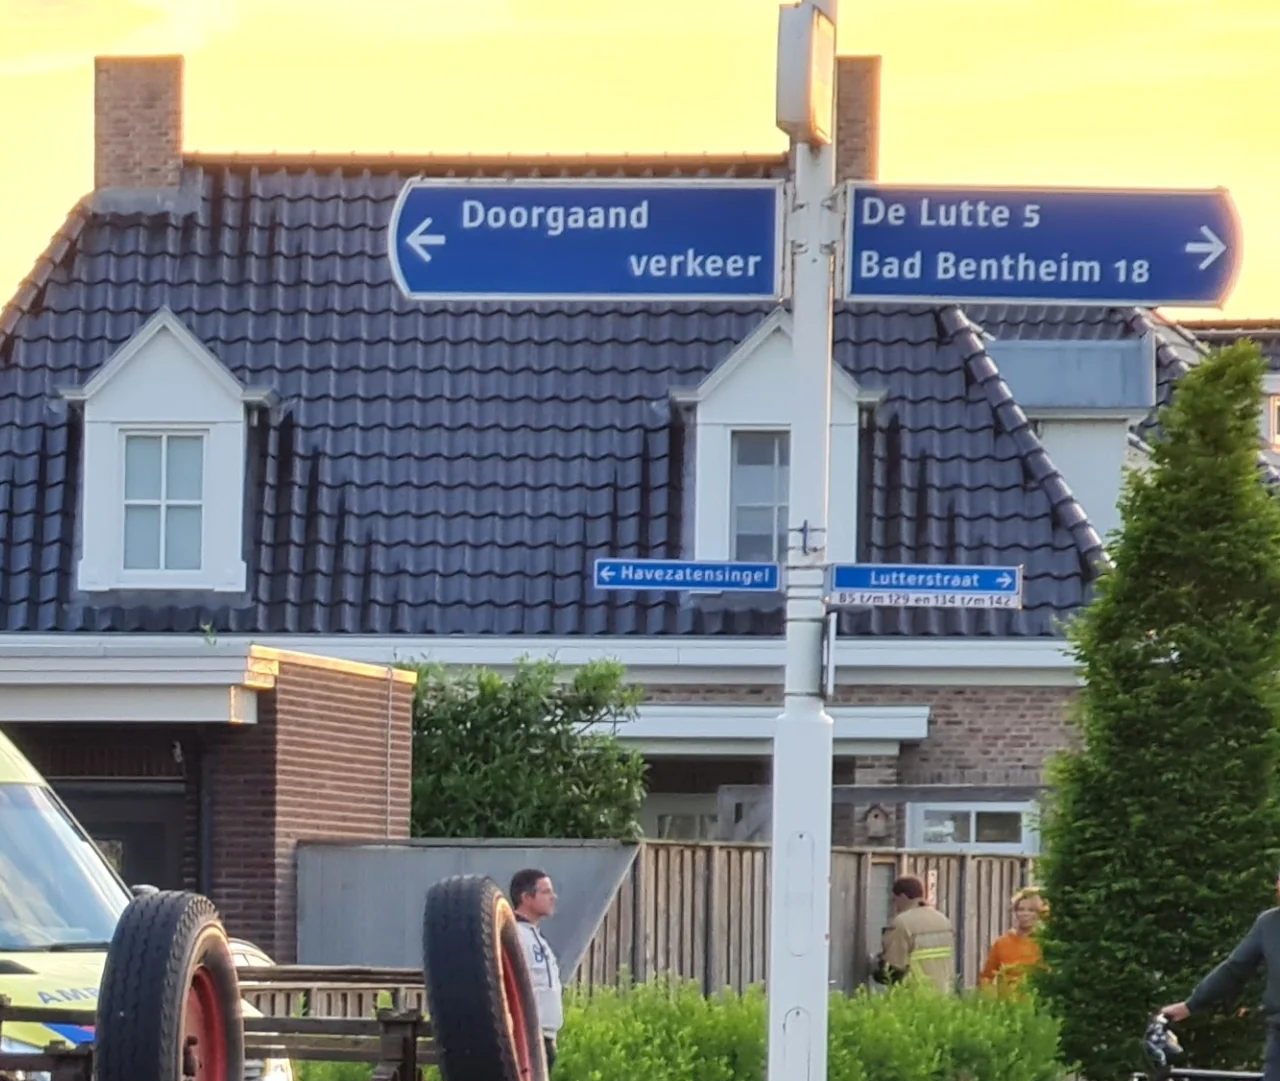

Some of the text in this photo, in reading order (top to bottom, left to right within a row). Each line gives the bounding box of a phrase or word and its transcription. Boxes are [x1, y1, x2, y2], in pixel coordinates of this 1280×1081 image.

[462, 200, 649, 236] Doorgaand
[862, 197, 1040, 228] De Lutte 5
[630, 249, 762, 277] verkeer
[860, 250, 1150, 283] Bad Bentheim 18
[621, 565, 769, 585] Havezatensingel
[870, 571, 980, 587] Lutterstraat
[860, 594, 884, 604] t/m
[889, 594, 909, 605] 129
[914, 597, 930, 605] en
[961, 597, 985, 606] t/m
[990, 596, 1011, 606] 142
